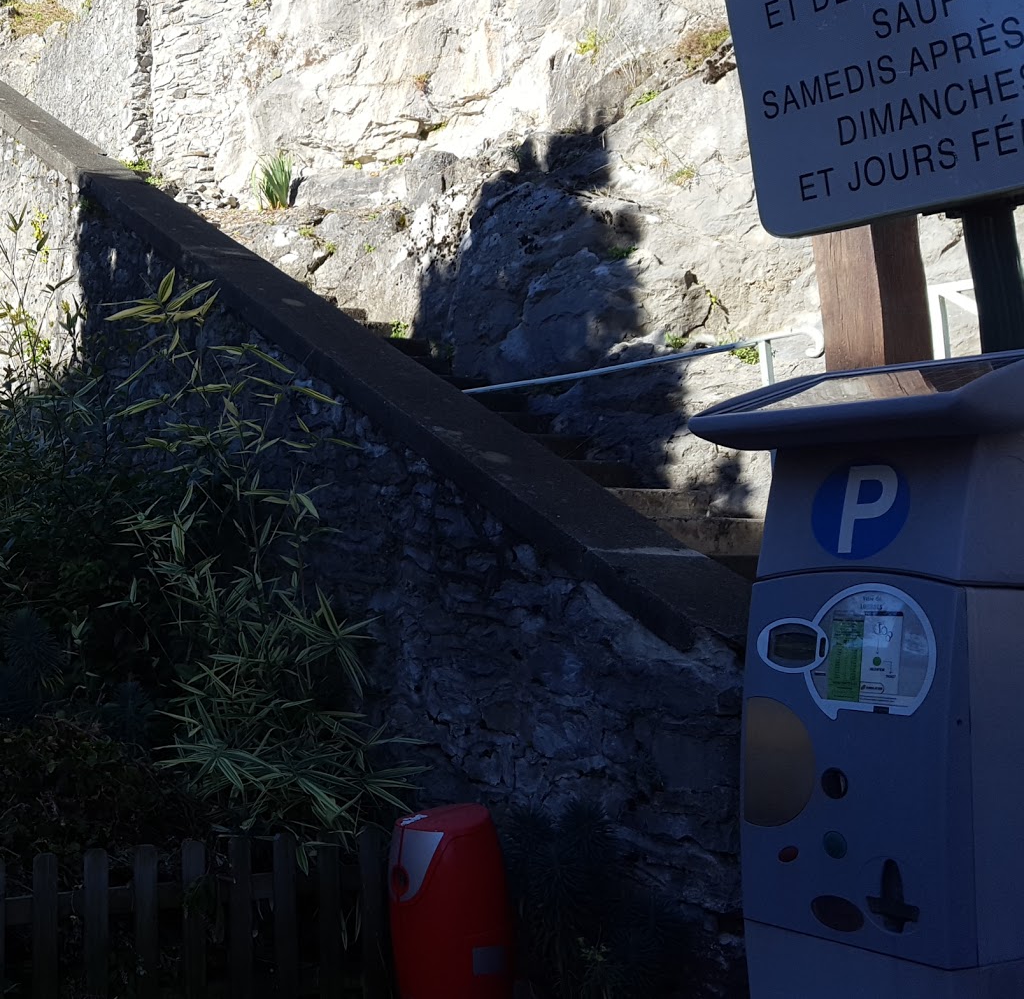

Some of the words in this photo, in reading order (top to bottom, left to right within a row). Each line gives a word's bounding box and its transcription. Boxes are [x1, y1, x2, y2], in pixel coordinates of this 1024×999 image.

[762, 54, 897, 120] SAMEDIS
[909, 17, 1024, 78] APRÈS
[836, 63, 1024, 147] DIMANCHE
[798, 167, 835, 202] ET
[847, 138, 959, 192] JOURS
[971, 113, 1024, 162] FÉ
[837, 465, 899, 553] P
